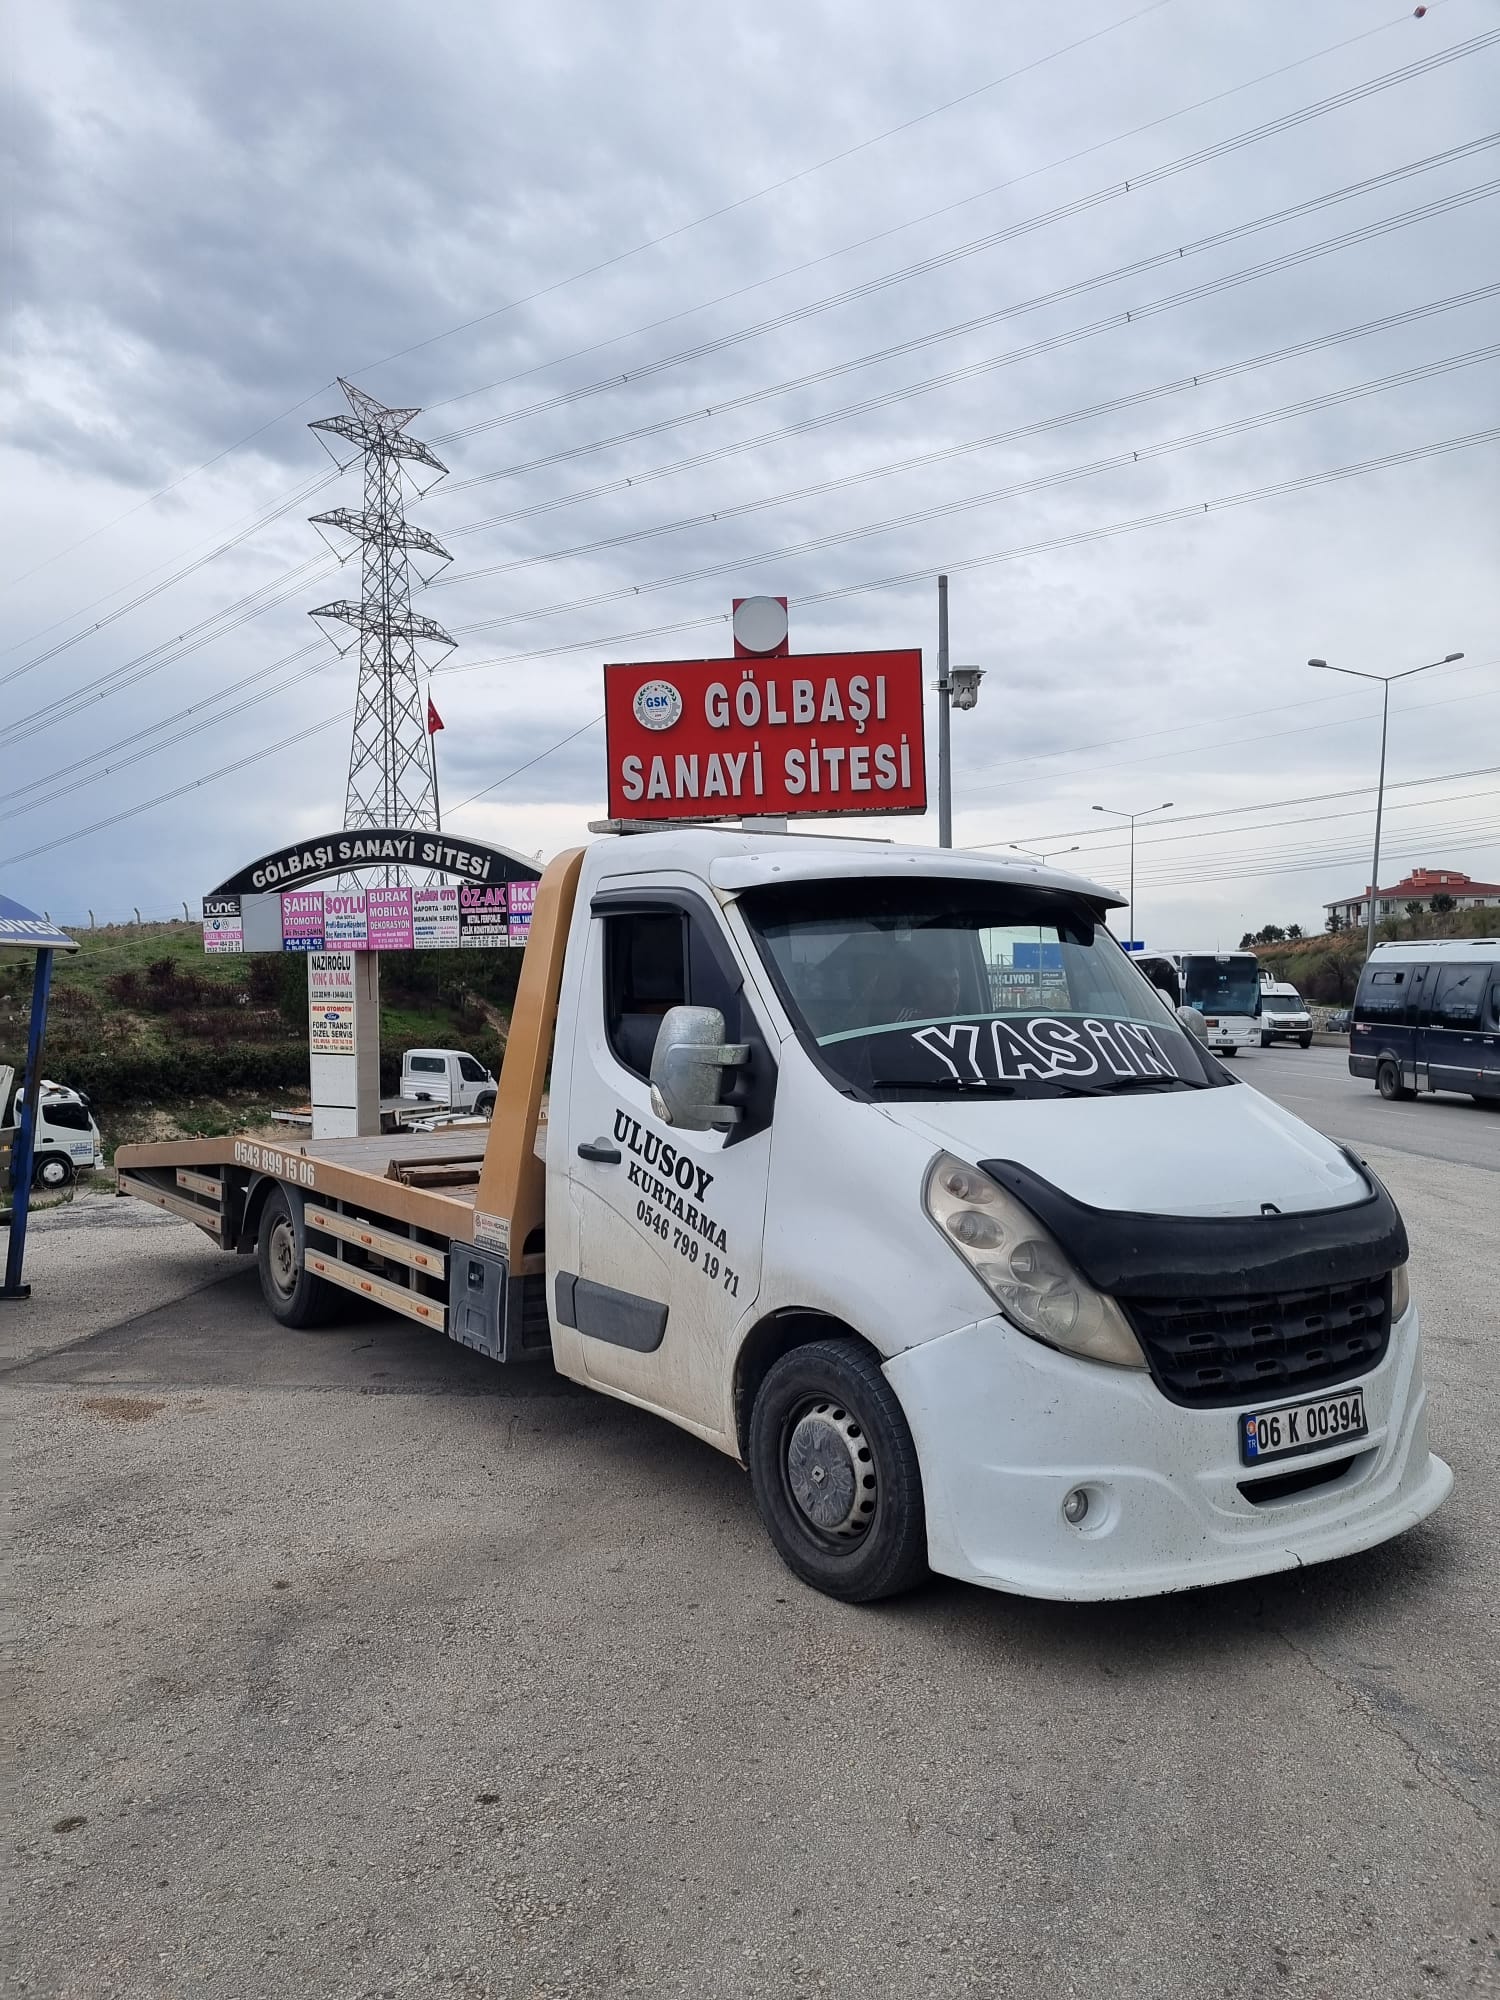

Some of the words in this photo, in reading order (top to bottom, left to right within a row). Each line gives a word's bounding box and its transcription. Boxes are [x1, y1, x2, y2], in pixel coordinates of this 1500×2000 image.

[646, 696, 668, 707] GSK
[704, 670, 886, 734] GÖLBAŞI
[621, 741, 764, 801] SANAYİ
[784, 733, 911, 795] SİTESİ
[252, 845, 334, 888] GÖLBAŞI
[339, 836, 416, 860] SANAYİ
[421, 840, 492, 879] SİTESİ
[283, 894, 322, 916] ŞAHİN
[325, 896, 366, 914] SOYLU
[369, 890, 408, 903] BURAK
[284, 915, 322, 926] OTOMOTİV
[369, 904, 409, 917] MOBİLYA
[0, 916, 66, 935] DİYESİ
[370, 919, 410, 930] DEKORASYON
[312, 952, 351, 971] NAZİROĞLU
[313, 1021, 328, 1029] FORD
[234, 1141, 260, 1168] 0543
[261, 1149, 283, 1175] 899
[284, 1156, 297, 1180] 15
[299, 1161, 315, 1187] 06
[613, 1108, 714, 1203] ULUSOY
[627, 1160, 727, 1253] KURTARMA
[636, 1199, 670, 1241] 0546
[673, 1226, 699, 1263] 799
[702, 1252, 720, 1280] 19
[723, 1266, 740, 1299] 71
[1248, 1439, 1257, 1449] TR
[1257, 1416, 1281, 1450] 06
[1288, 1411, 1300, 1443] K
[1306, 1398, 1361, 1438] 00394
